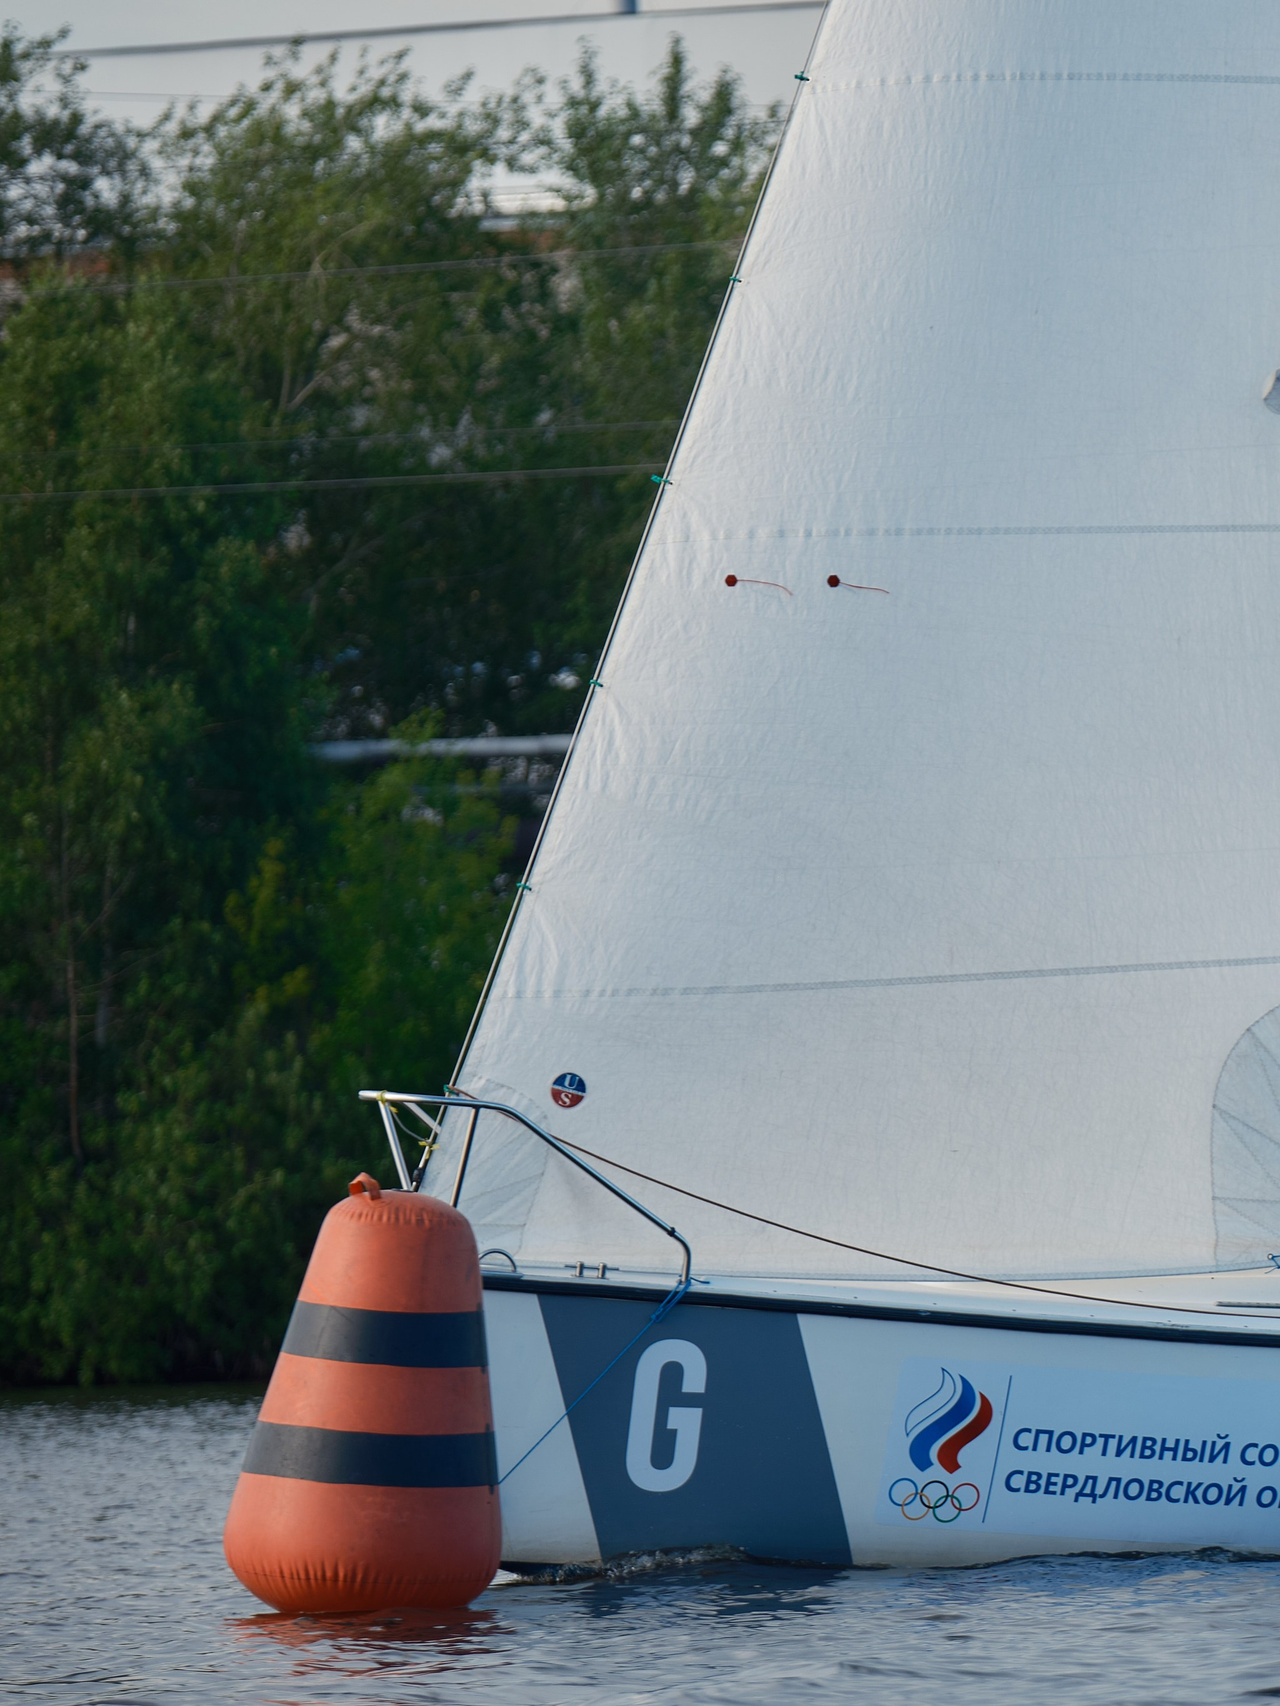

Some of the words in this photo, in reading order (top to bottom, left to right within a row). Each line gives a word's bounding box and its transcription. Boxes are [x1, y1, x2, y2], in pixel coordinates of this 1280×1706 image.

[625, 1338, 708, 1492] G
[1012, 1427, 1232, 1465] СПОРТИВНЫЙ
[1004, 1469, 1248, 1507] СВЕРДЛОВСКОЙ
